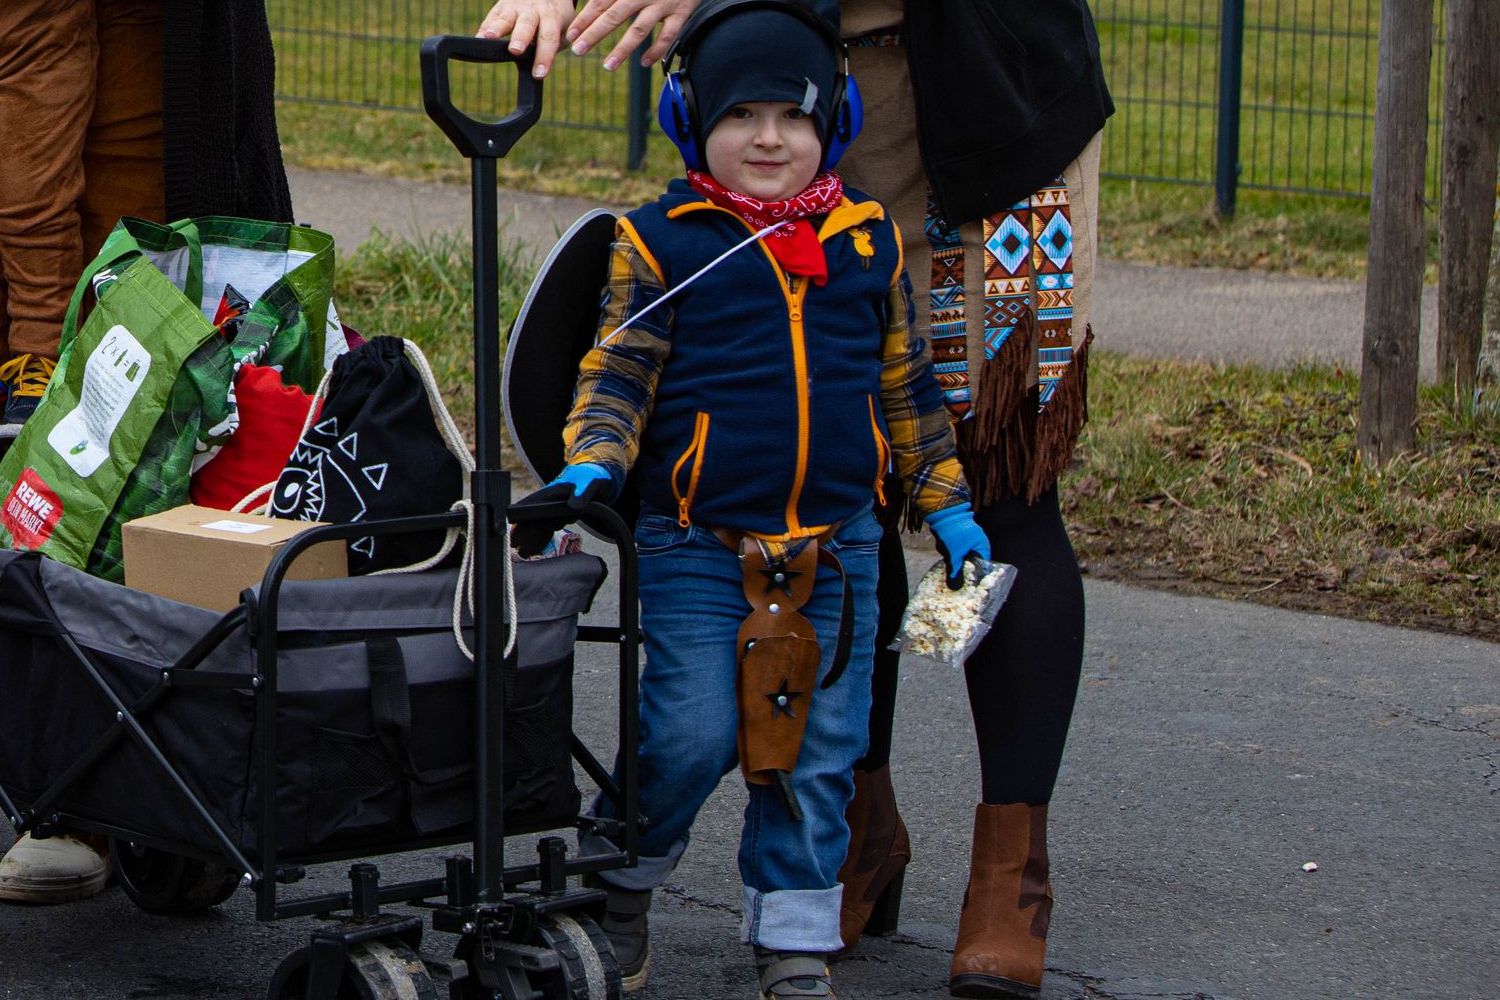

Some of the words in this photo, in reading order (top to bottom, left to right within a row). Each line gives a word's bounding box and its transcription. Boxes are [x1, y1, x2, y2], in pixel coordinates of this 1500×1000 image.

[7, 496, 23, 520] DEIN
[17, 507, 45, 536] MARKT
[16, 480, 54, 521] REWE
